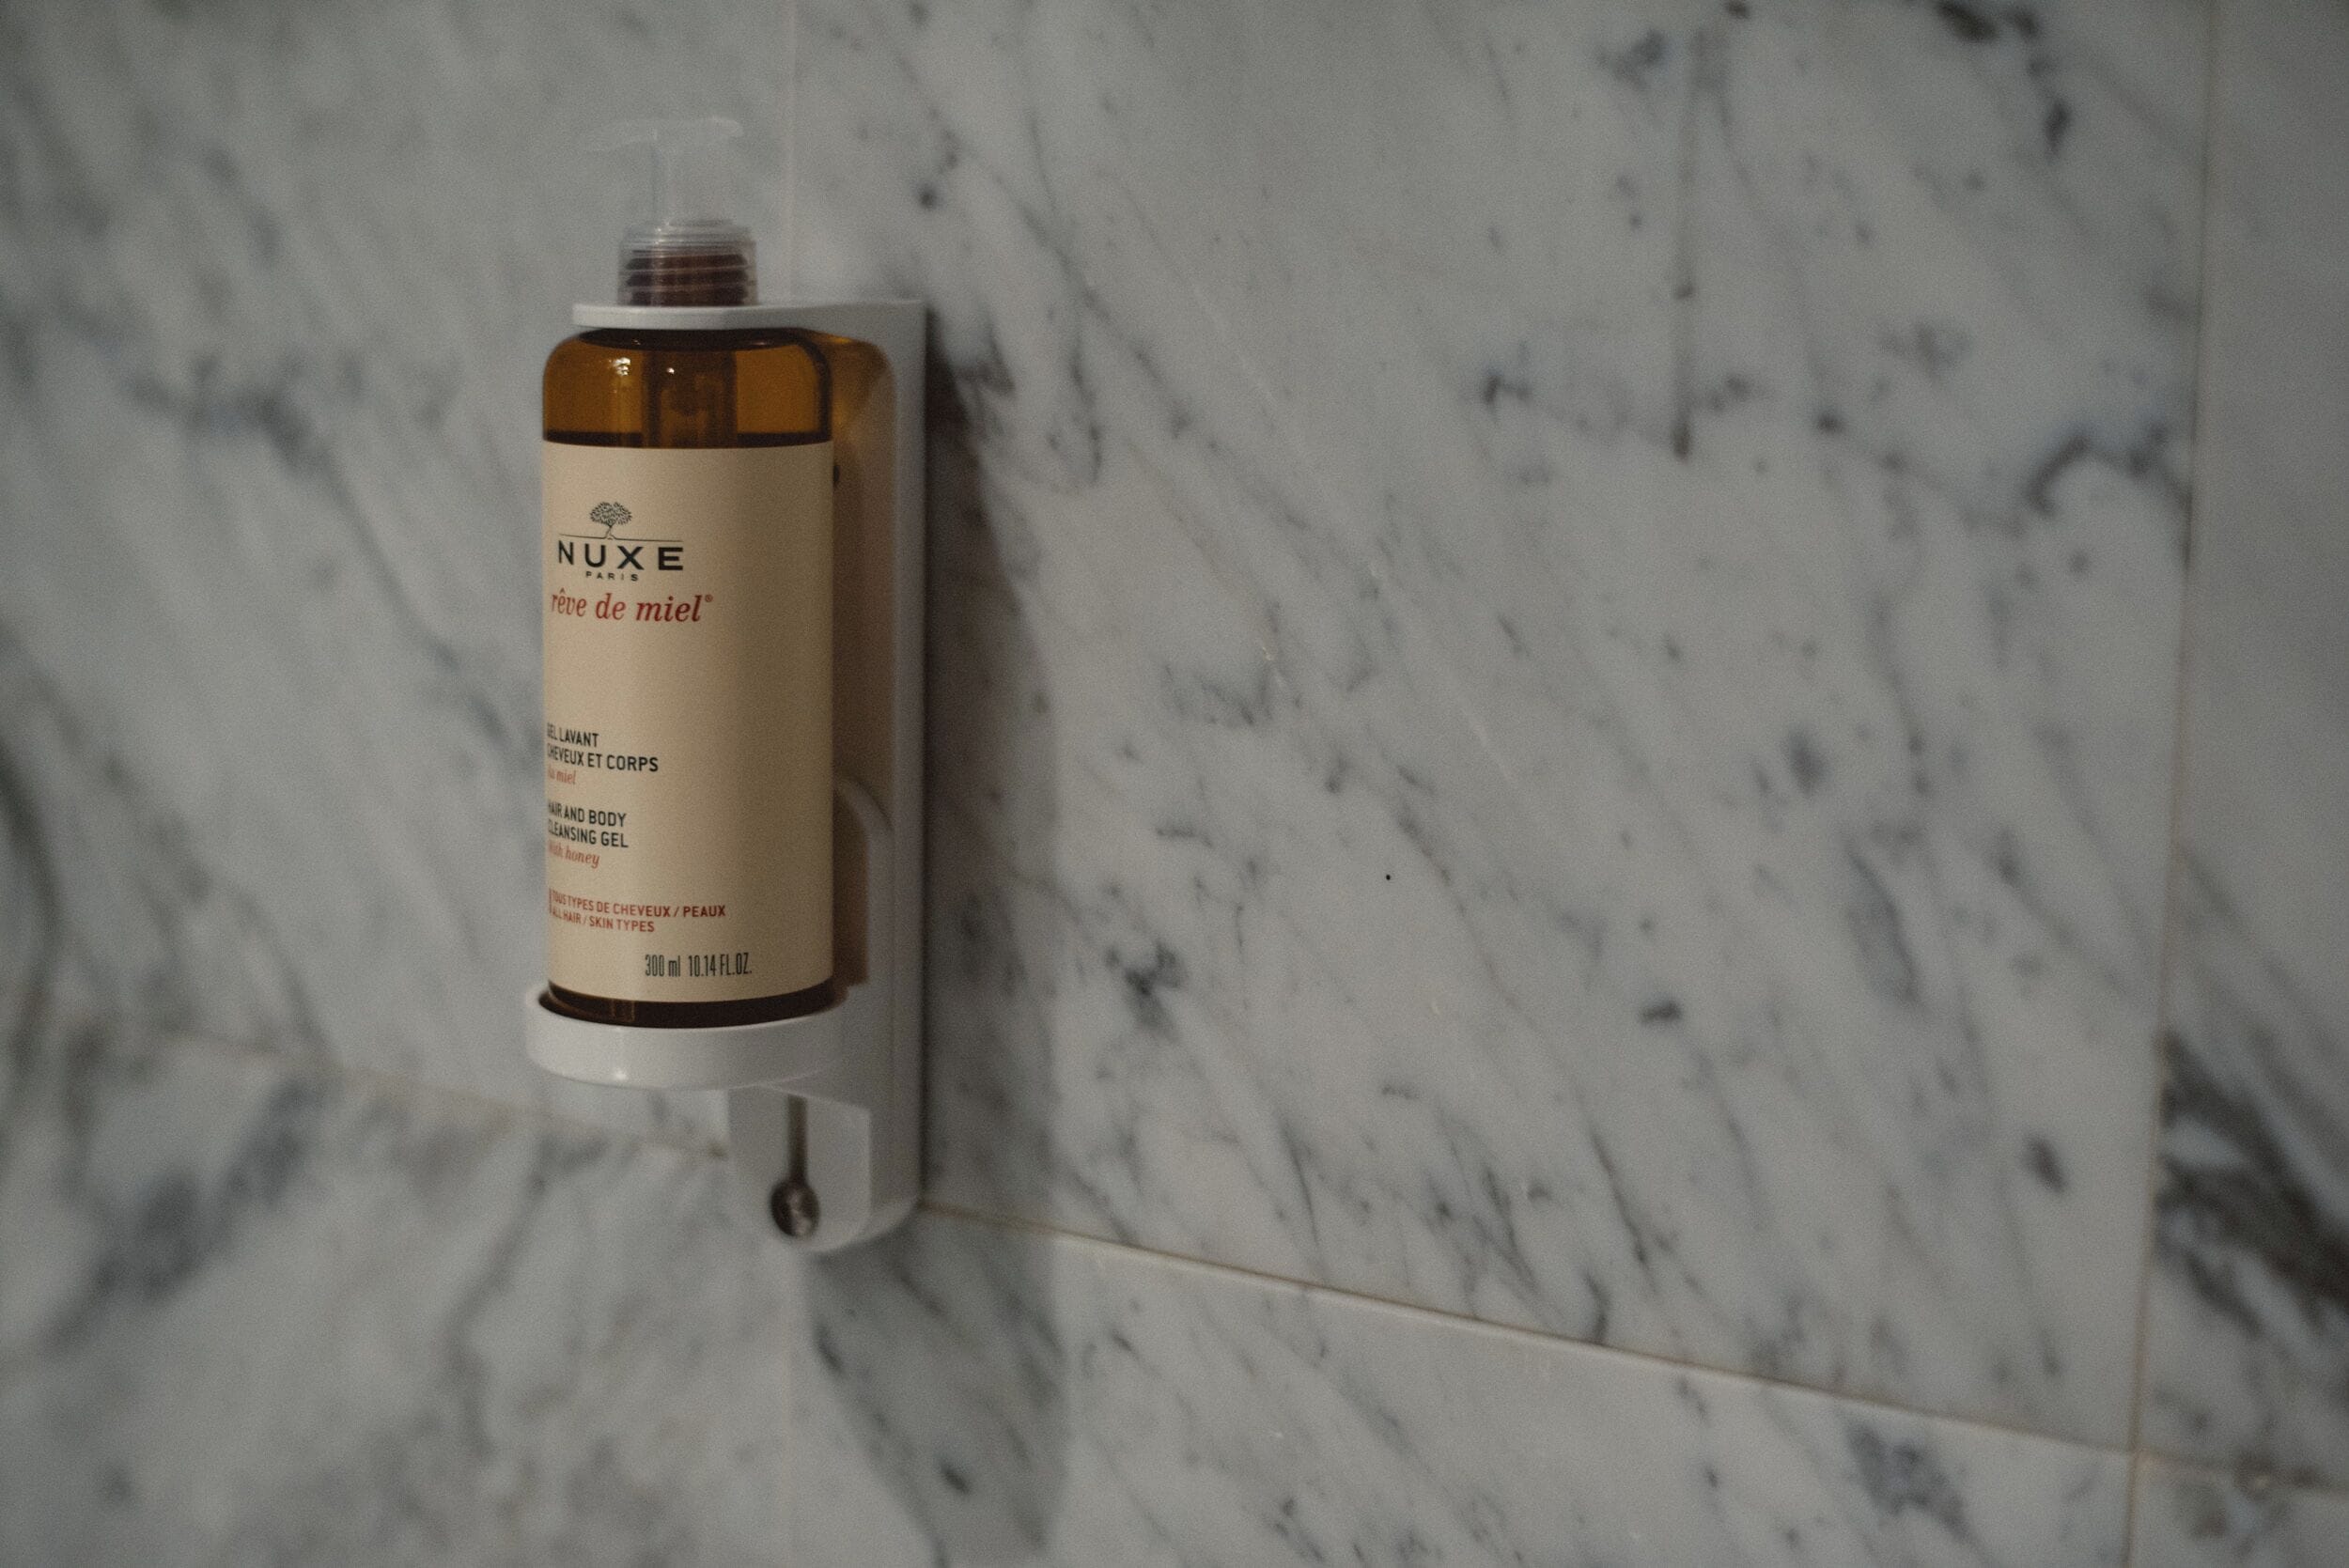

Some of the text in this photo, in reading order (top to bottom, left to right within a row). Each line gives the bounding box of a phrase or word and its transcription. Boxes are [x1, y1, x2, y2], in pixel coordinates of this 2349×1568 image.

[558, 539, 684, 571] NUXE
[585, 570, 639, 582] PARIS
[551, 587, 587, 617] rêve
[595, 593, 627, 620] de
[559, 727, 600, 748] LAVANT
[587, 753, 603, 768] ET
[606, 754, 660, 772] CORPS
[555, 768, 577, 785] miel
[564, 805, 585, 823] AND
[588, 809, 628, 828] BODY
[600, 831, 630, 848] GEL
[565, 845, 600, 869] honey
[568, 895, 594, 911] TYPES
[597, 901, 611, 913] DE
[613, 903, 671, 918] CHEVEUX
[682, 905, 727, 918] PEAUX
[564, 909, 582, 924] HAIR
[589, 915, 614, 929] SKIN
[616, 918, 656, 933] TYPES
[645, 954, 666, 977] 300
[668, 955, 681, 978] ml
[688, 954, 717, 977] 10.14
